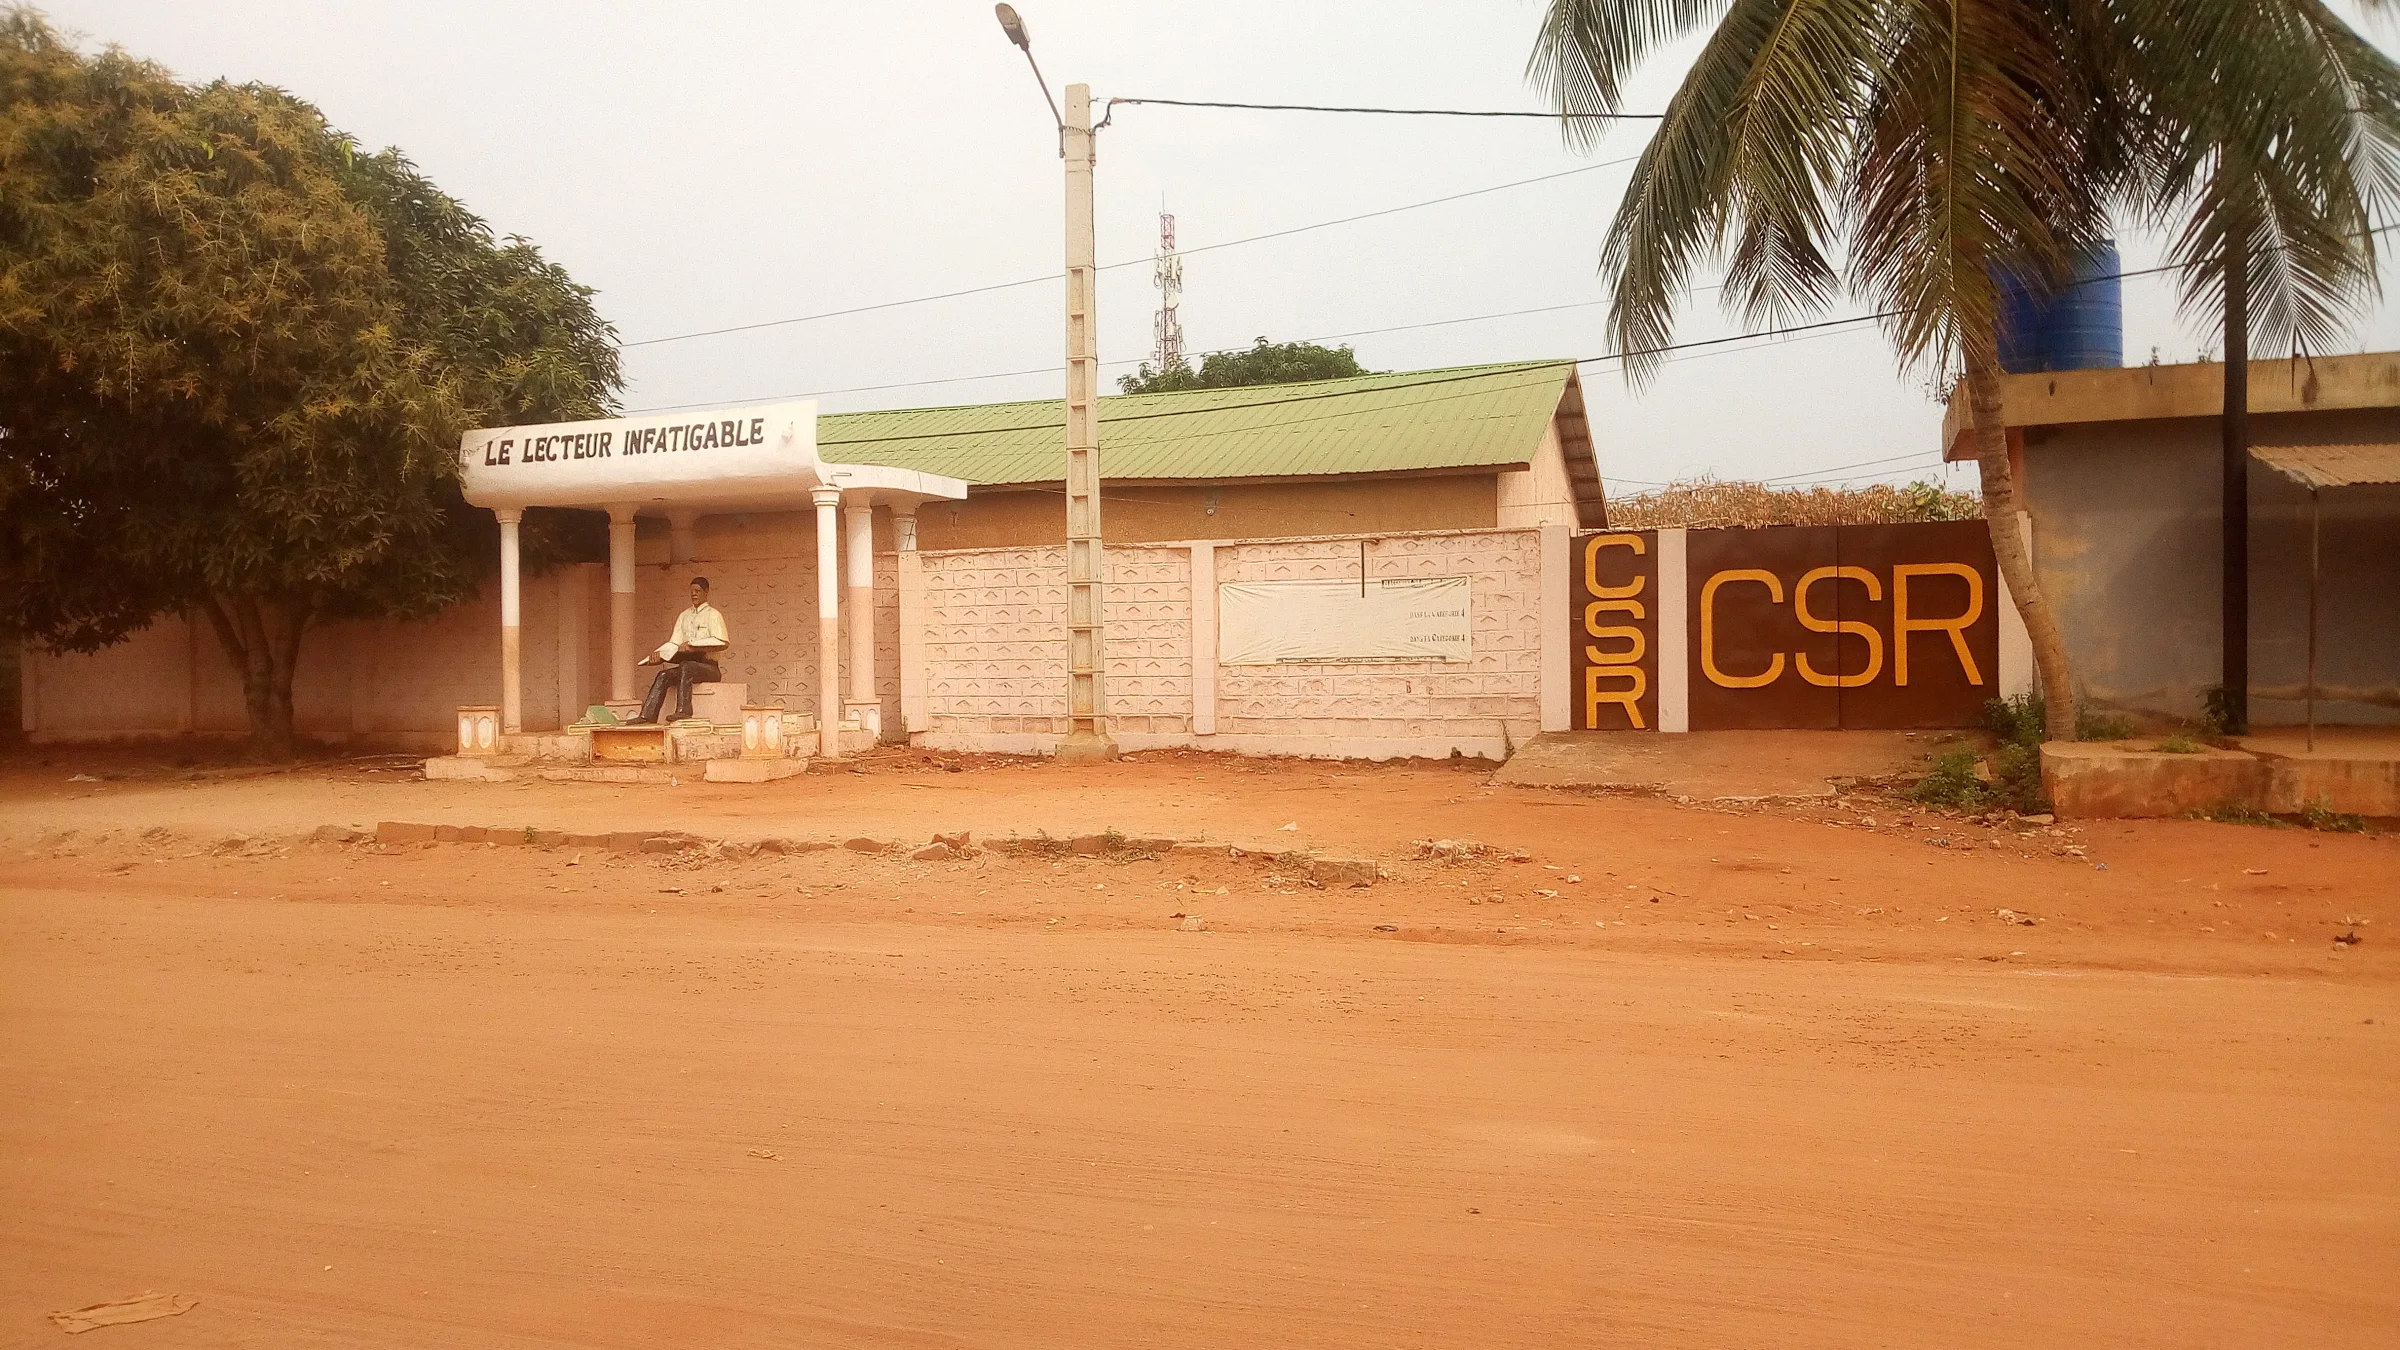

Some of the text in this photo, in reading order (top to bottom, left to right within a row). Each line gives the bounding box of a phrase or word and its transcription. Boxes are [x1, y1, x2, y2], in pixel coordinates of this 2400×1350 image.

[484, 418, 765, 466] LE LECTEUR INFATIGABLE
[1584, 533, 1647, 729] CSR
[1700, 562, 1984, 688] CSR
